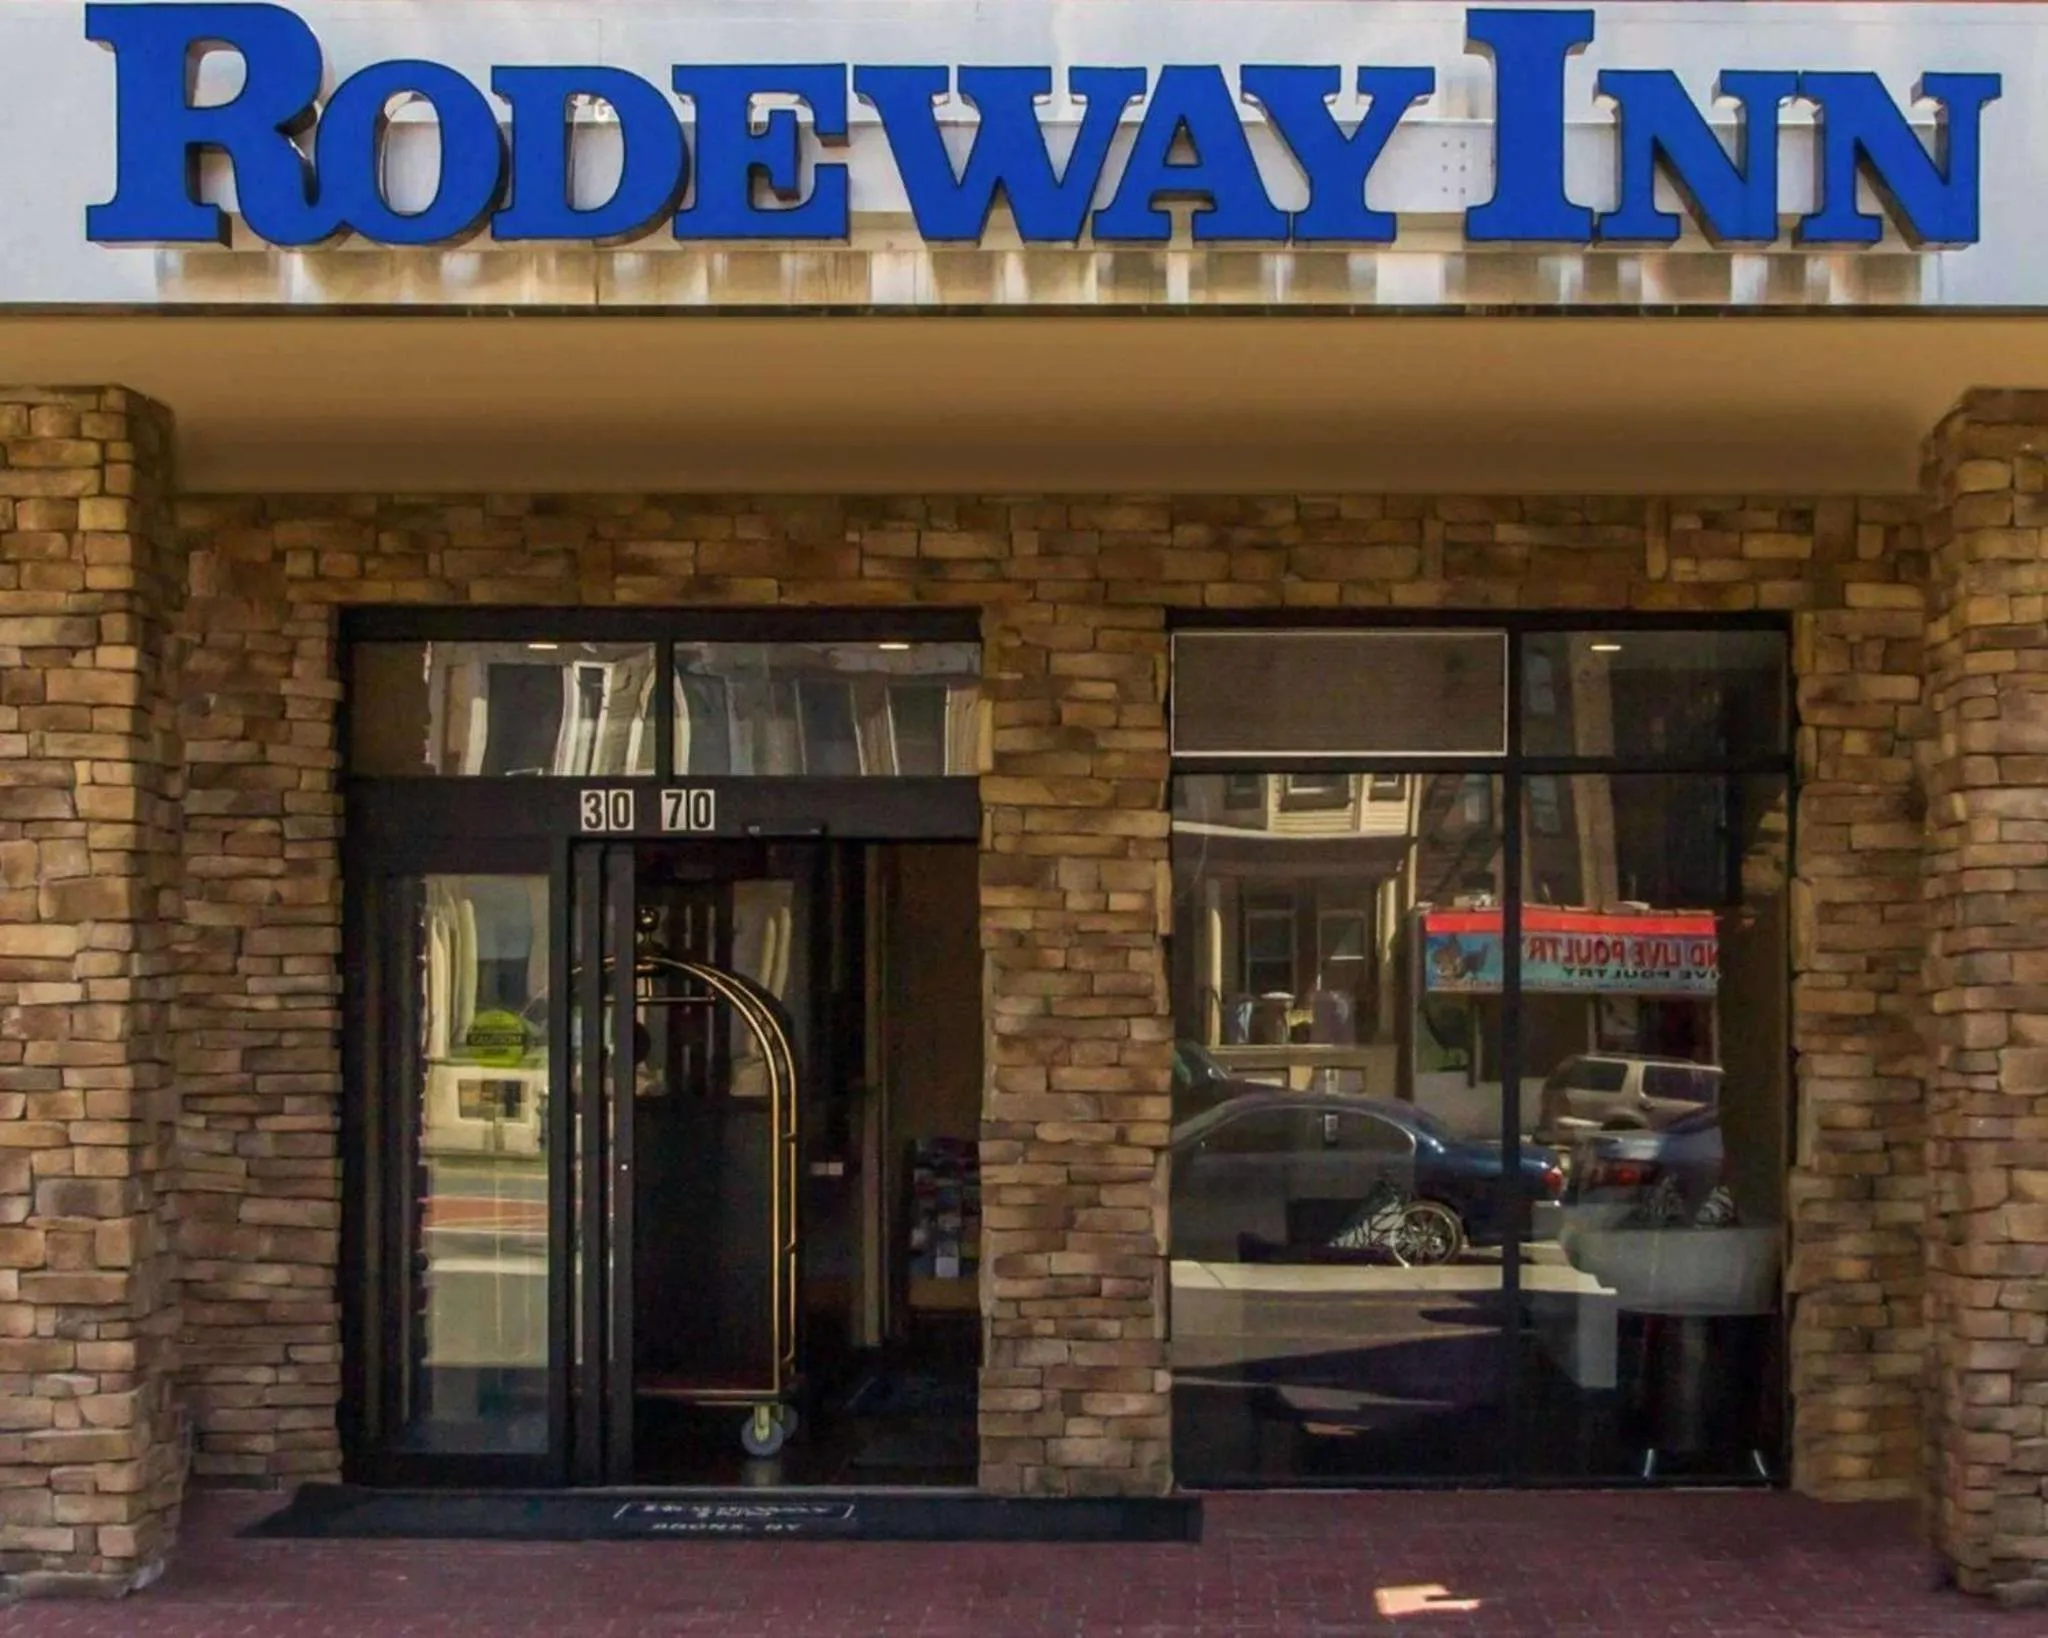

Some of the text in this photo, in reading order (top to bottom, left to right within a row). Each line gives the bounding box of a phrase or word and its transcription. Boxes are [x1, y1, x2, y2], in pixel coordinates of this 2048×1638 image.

[85, 2, 2000, 247] RODEWAY INN
[583, 791, 712, 829] 30 70
